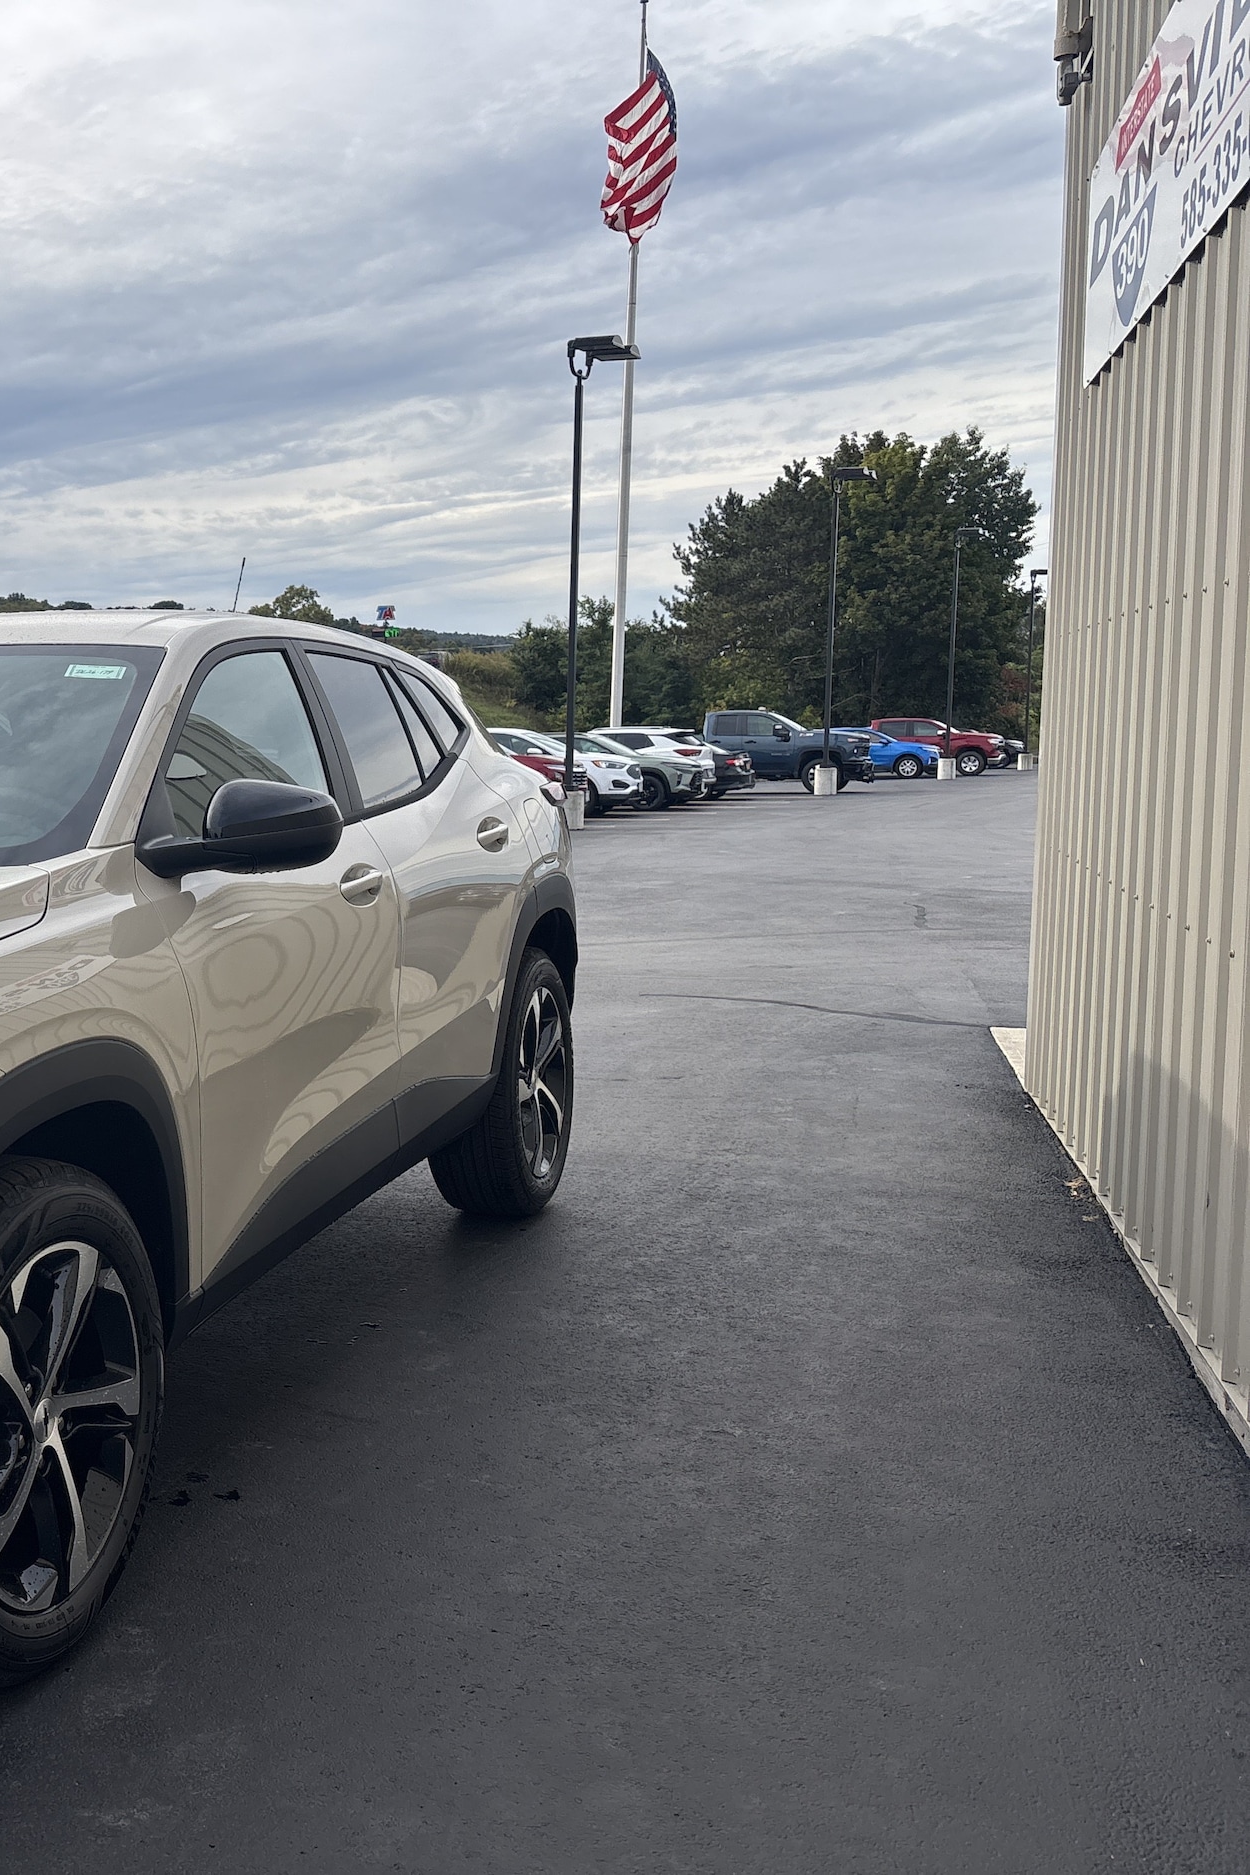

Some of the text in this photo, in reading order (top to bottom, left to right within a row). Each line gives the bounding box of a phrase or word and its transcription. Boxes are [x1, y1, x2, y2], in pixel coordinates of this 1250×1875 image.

[1174, 38, 1250, 178] CHEVR
[1181, 110, 1250, 249] 585-335-
[1116, 207, 1149, 299] 390
[376, 605, 396, 620] TA
